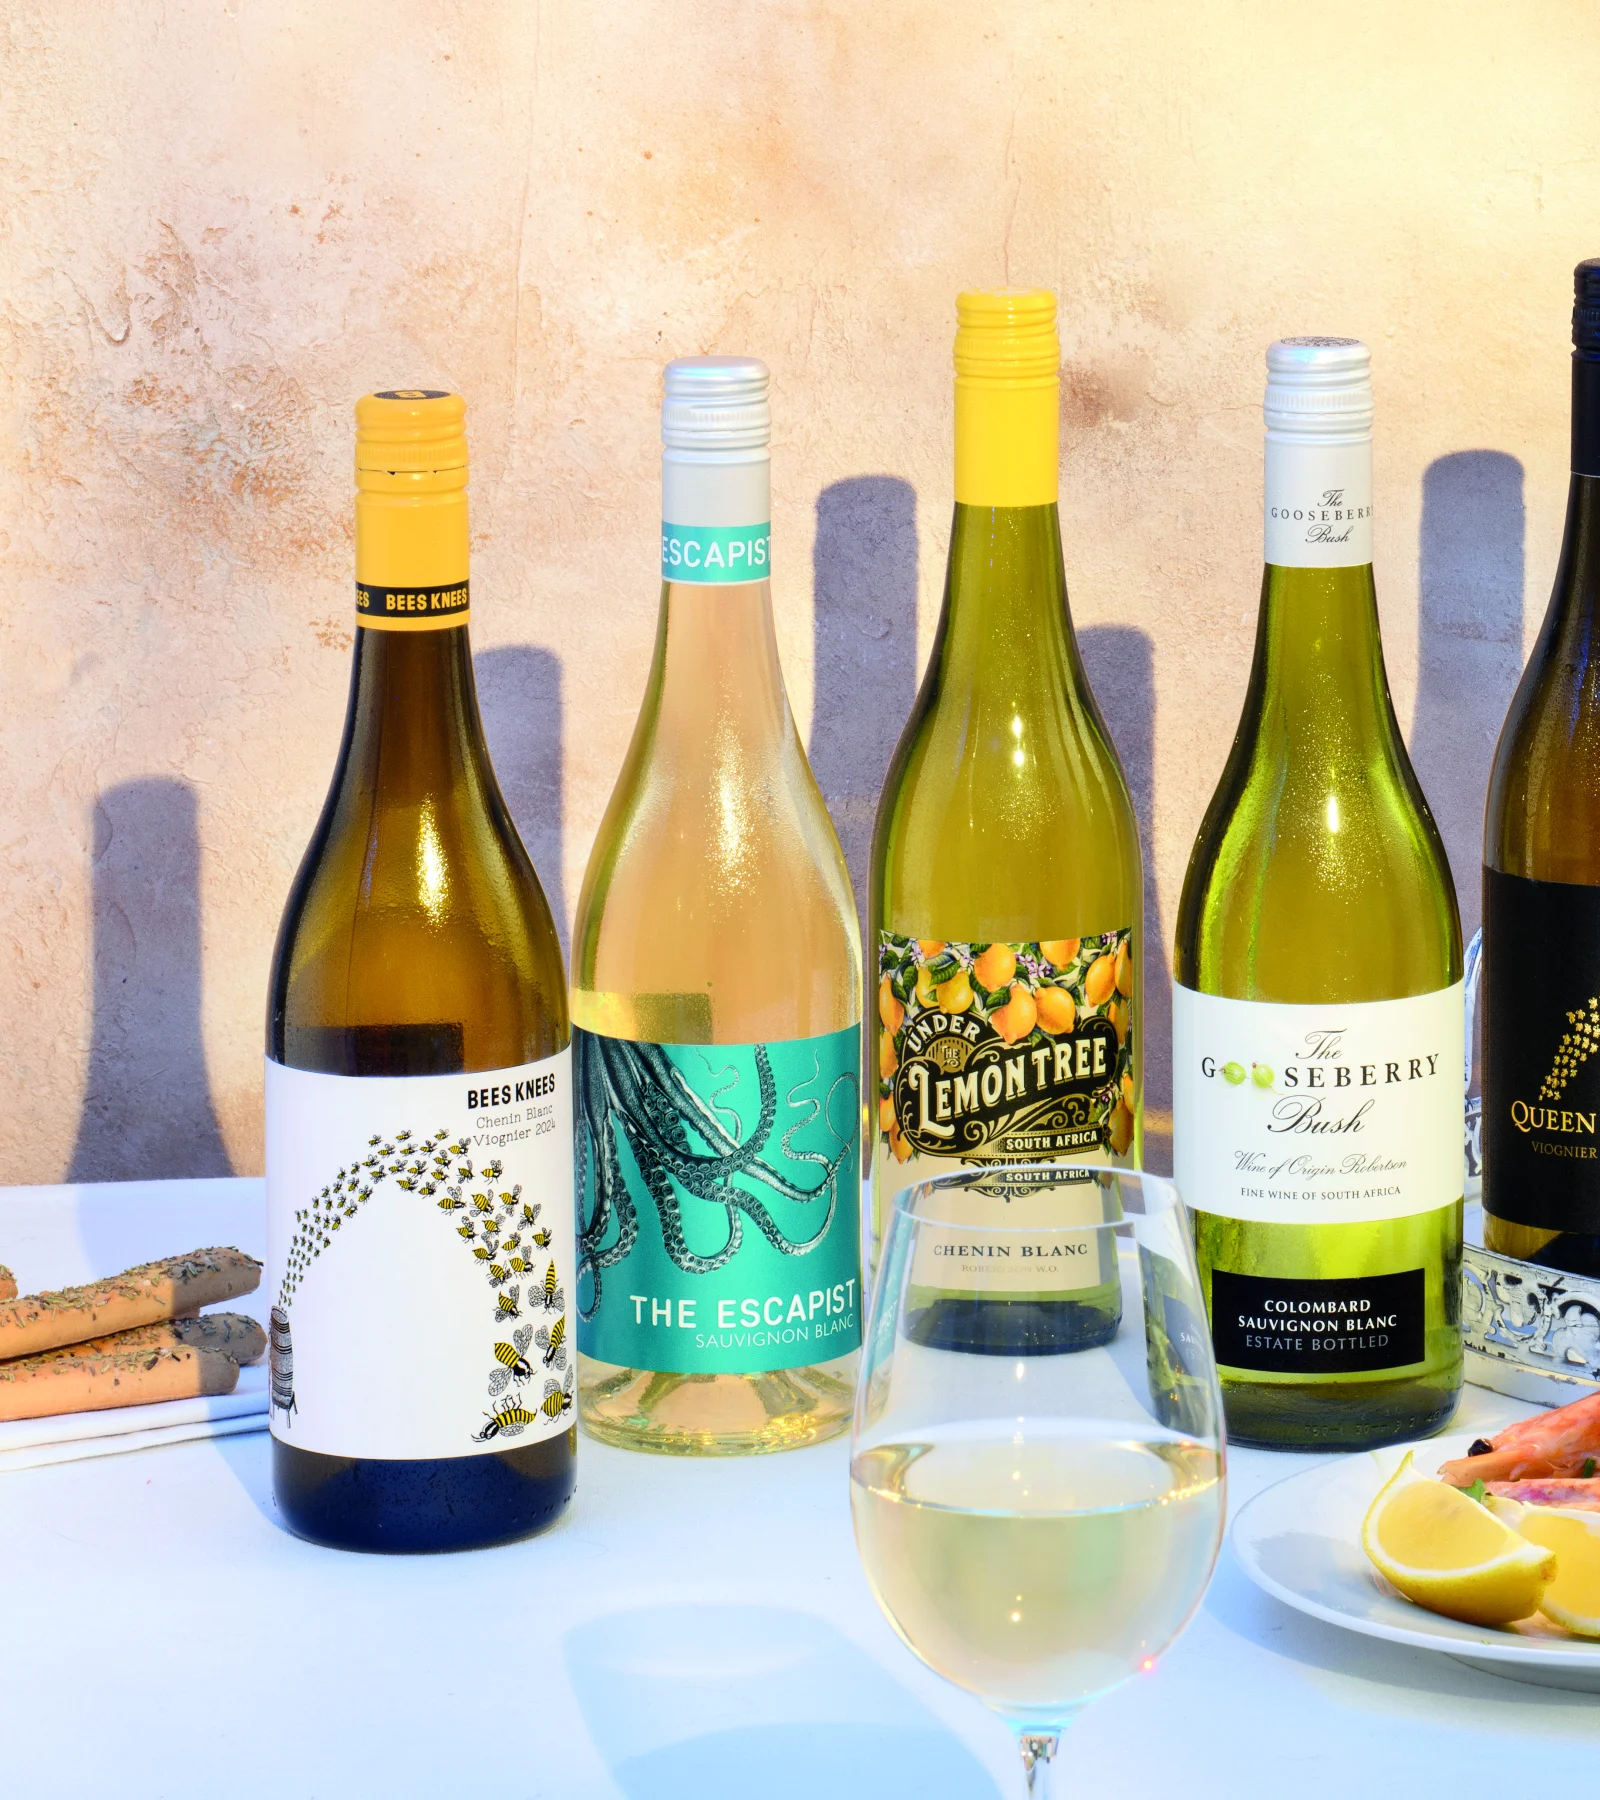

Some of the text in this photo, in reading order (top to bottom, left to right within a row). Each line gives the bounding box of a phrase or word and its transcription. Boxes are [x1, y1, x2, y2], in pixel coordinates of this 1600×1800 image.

[1317, 488, 1345, 508] The
[1304, 524, 1354, 544] Bush
[386, 588, 468, 610] BEES KNEES
[907, 1014, 980, 1054] UNDER
[1295, 1028, 1348, 1060] The
[941, 1045, 959, 1060] THE
[468, 1072, 555, 1110] BEES KNEES
[907, 1037, 1108, 1138] LEMON TREE
[476, 1104, 553, 1129] Chenin Blanc
[1266, 1094, 1376, 1134] Bush
[1510, 1100, 1597, 1134] QUEEN
[472, 1118, 556, 1148] Viognier 2024
[1006, 1130, 1098, 1150] SOUTH AFRICA
[1530, 1140, 1598, 1159] VIOGNIER
[1006, 1170, 1090, 1182] SOUTH AFRICA
[1234, 1150, 1408, 1181] Wine of Origin Robertson
[1240, 1186, 1402, 1200] FINE WINE OF SOUTH AFRICA
[934, 1244, 1088, 1258] CHENIN BLANC
[630, 1294, 698, 1329] THE
[718, 1278, 856, 1329] ESCAPIST
[1264, 1299, 1371, 1314] COLOMBARD
[696, 1326, 808, 1349] SAUVIGNON
[815, 1314, 854, 1339] BLANC
[1238, 1314, 1397, 1332] SAUVIGNON BLANC
[1246, 1334, 1389, 1351] ESTATE BOTTLED
